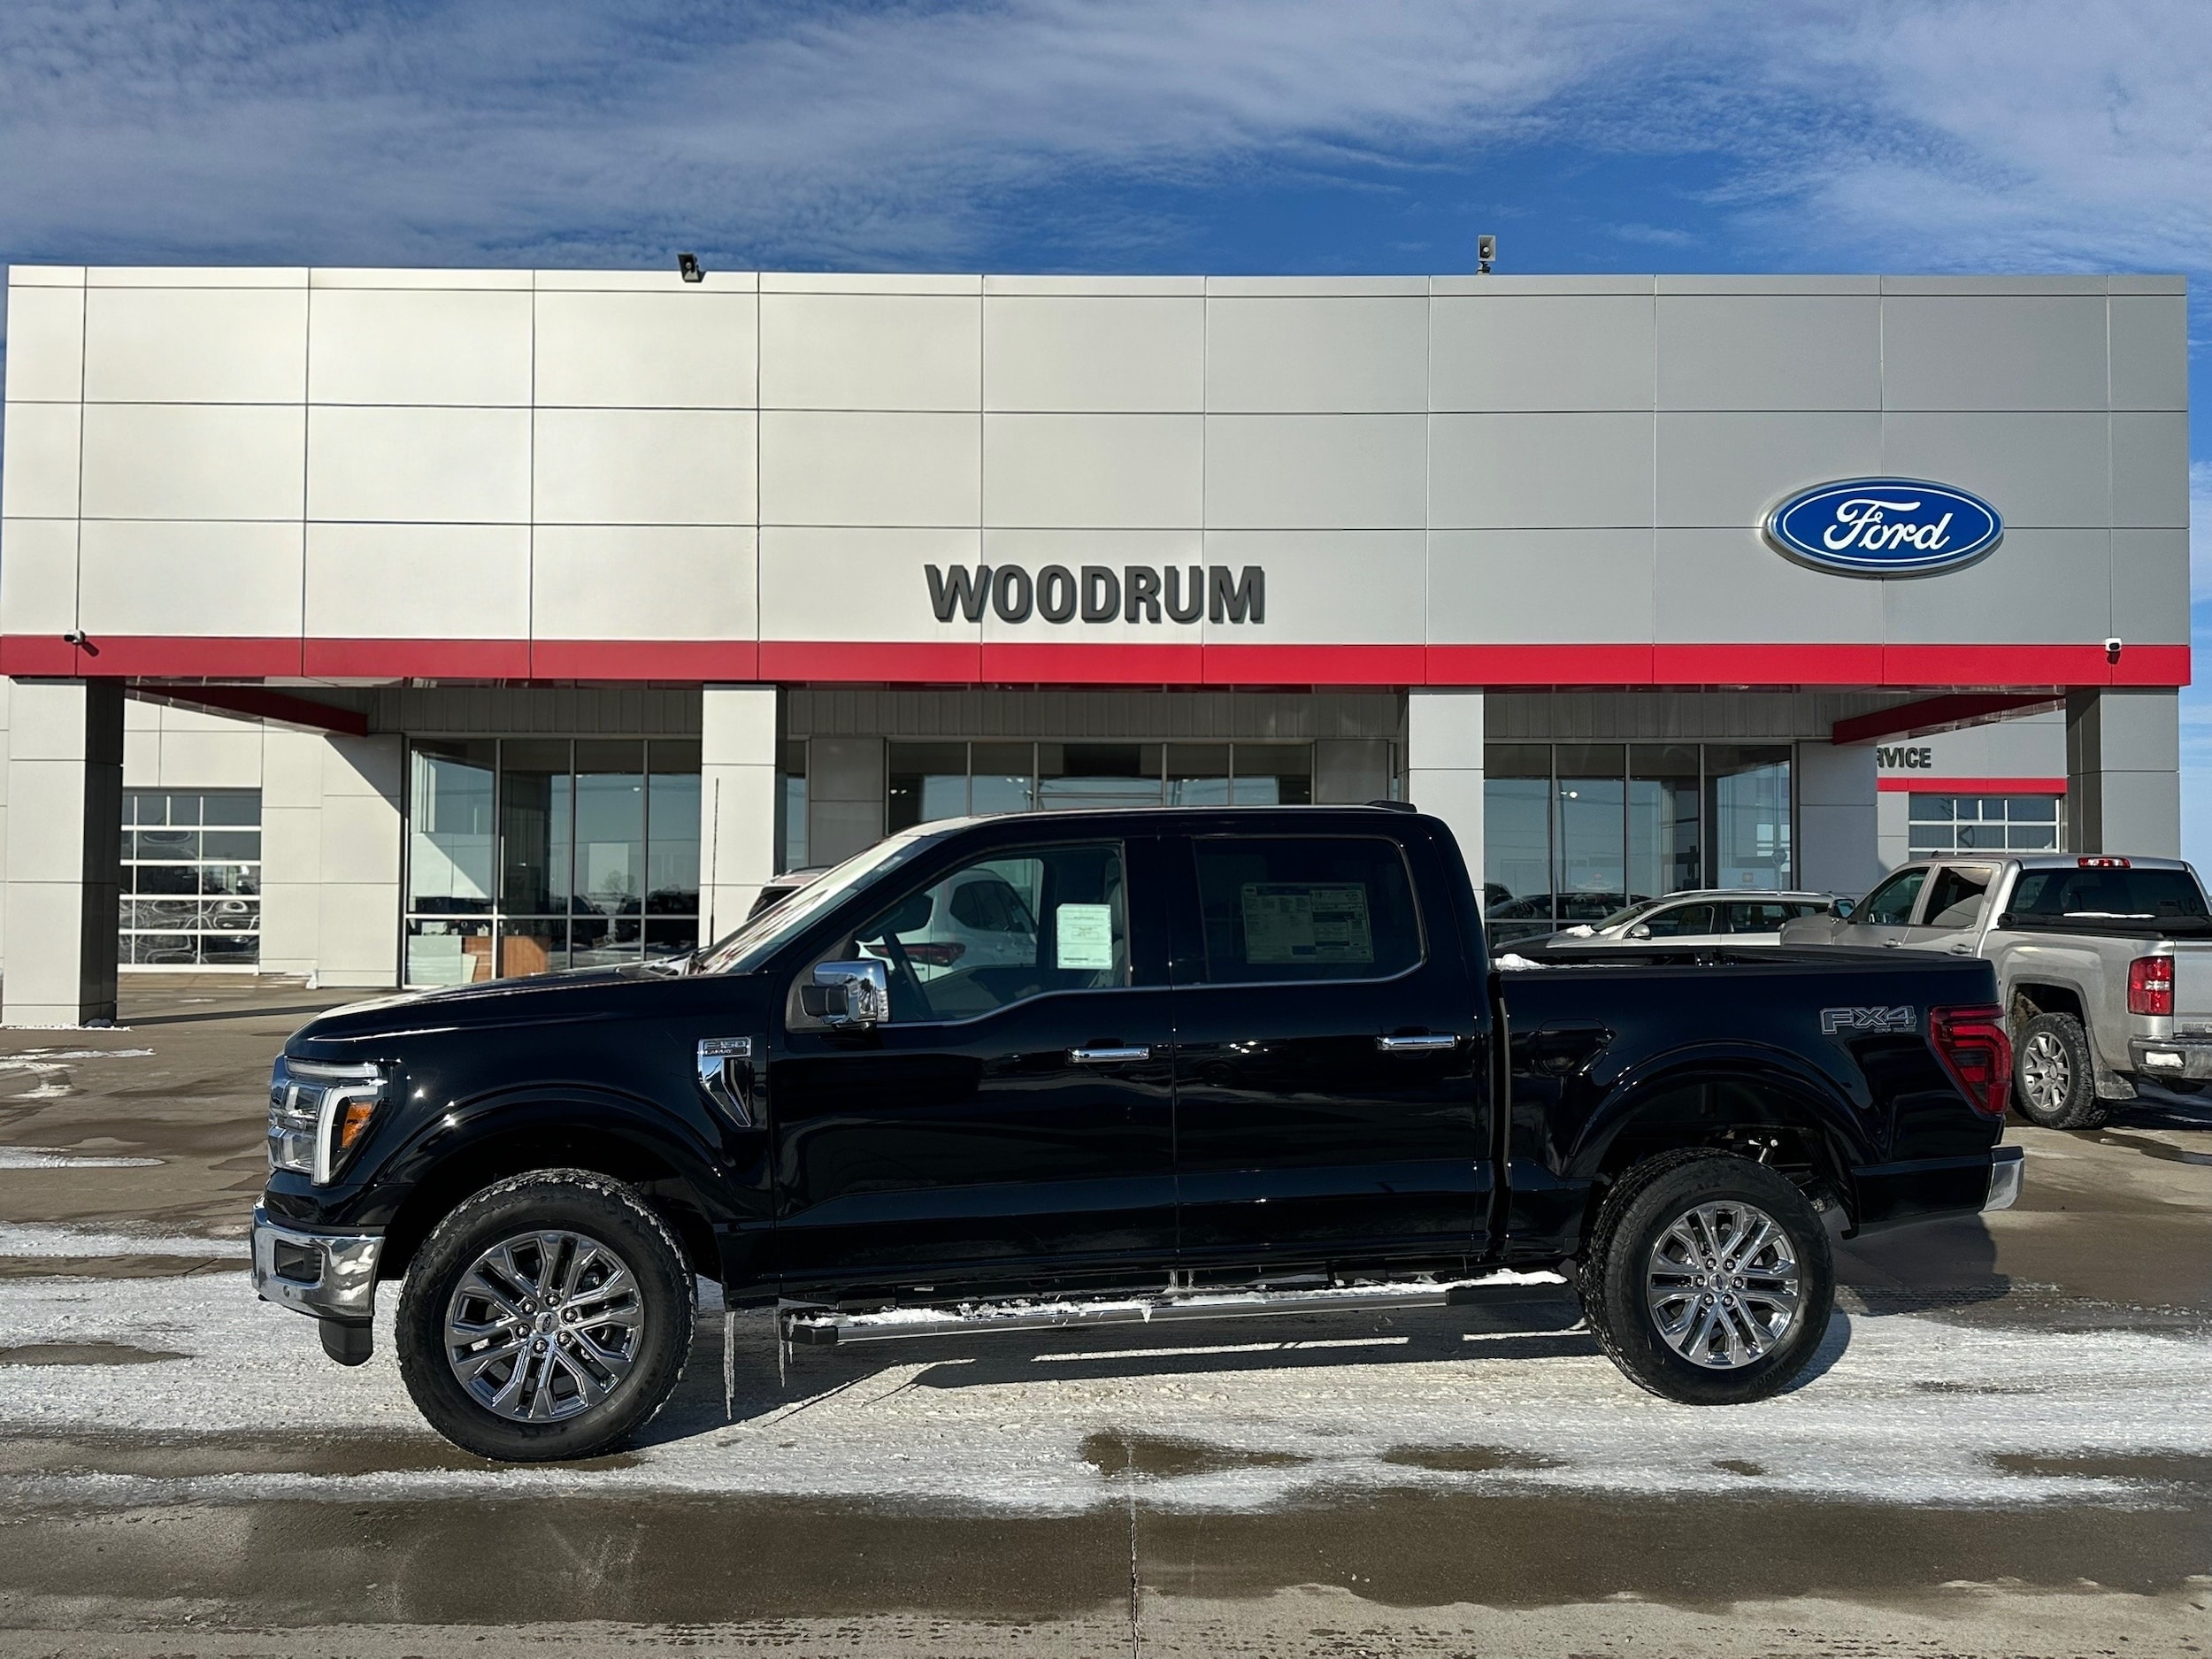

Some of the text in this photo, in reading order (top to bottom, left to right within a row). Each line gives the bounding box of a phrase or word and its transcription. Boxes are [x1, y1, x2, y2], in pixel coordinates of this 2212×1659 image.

[1823, 498, 1954, 550] Ford
[924, 564, 1264, 624] WOODRUM
[1820, 1005, 1916, 1034] FX4
